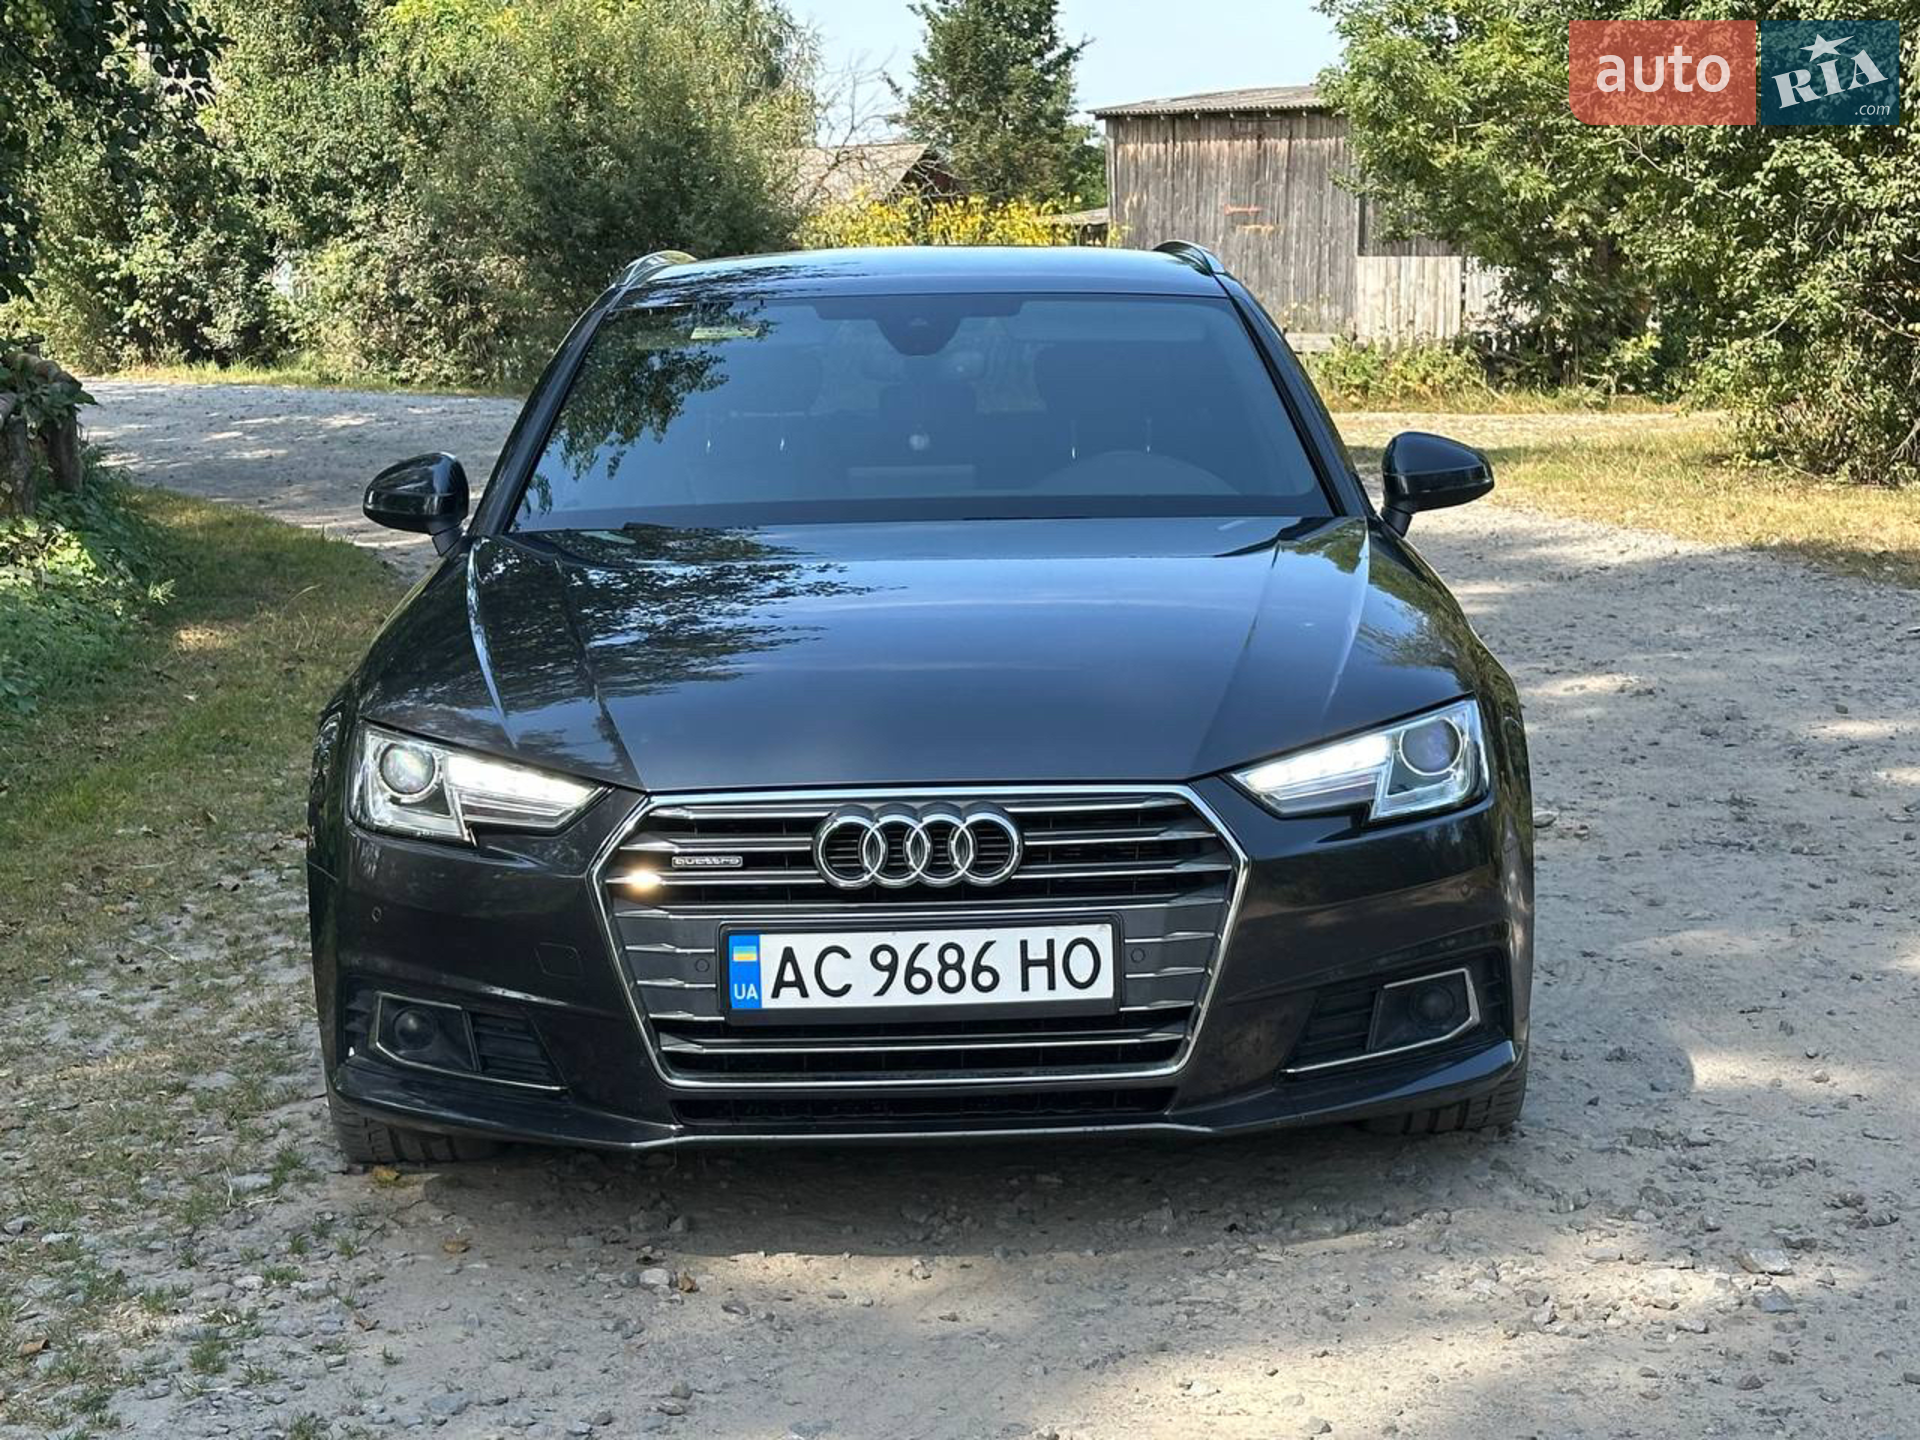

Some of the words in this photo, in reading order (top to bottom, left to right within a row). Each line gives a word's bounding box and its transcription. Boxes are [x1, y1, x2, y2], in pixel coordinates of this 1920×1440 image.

[771, 945, 852, 999] AC
[869, 940, 1001, 997] 9686
[1019, 937, 1102, 993] HO
[733, 983, 759, 1000] UA
